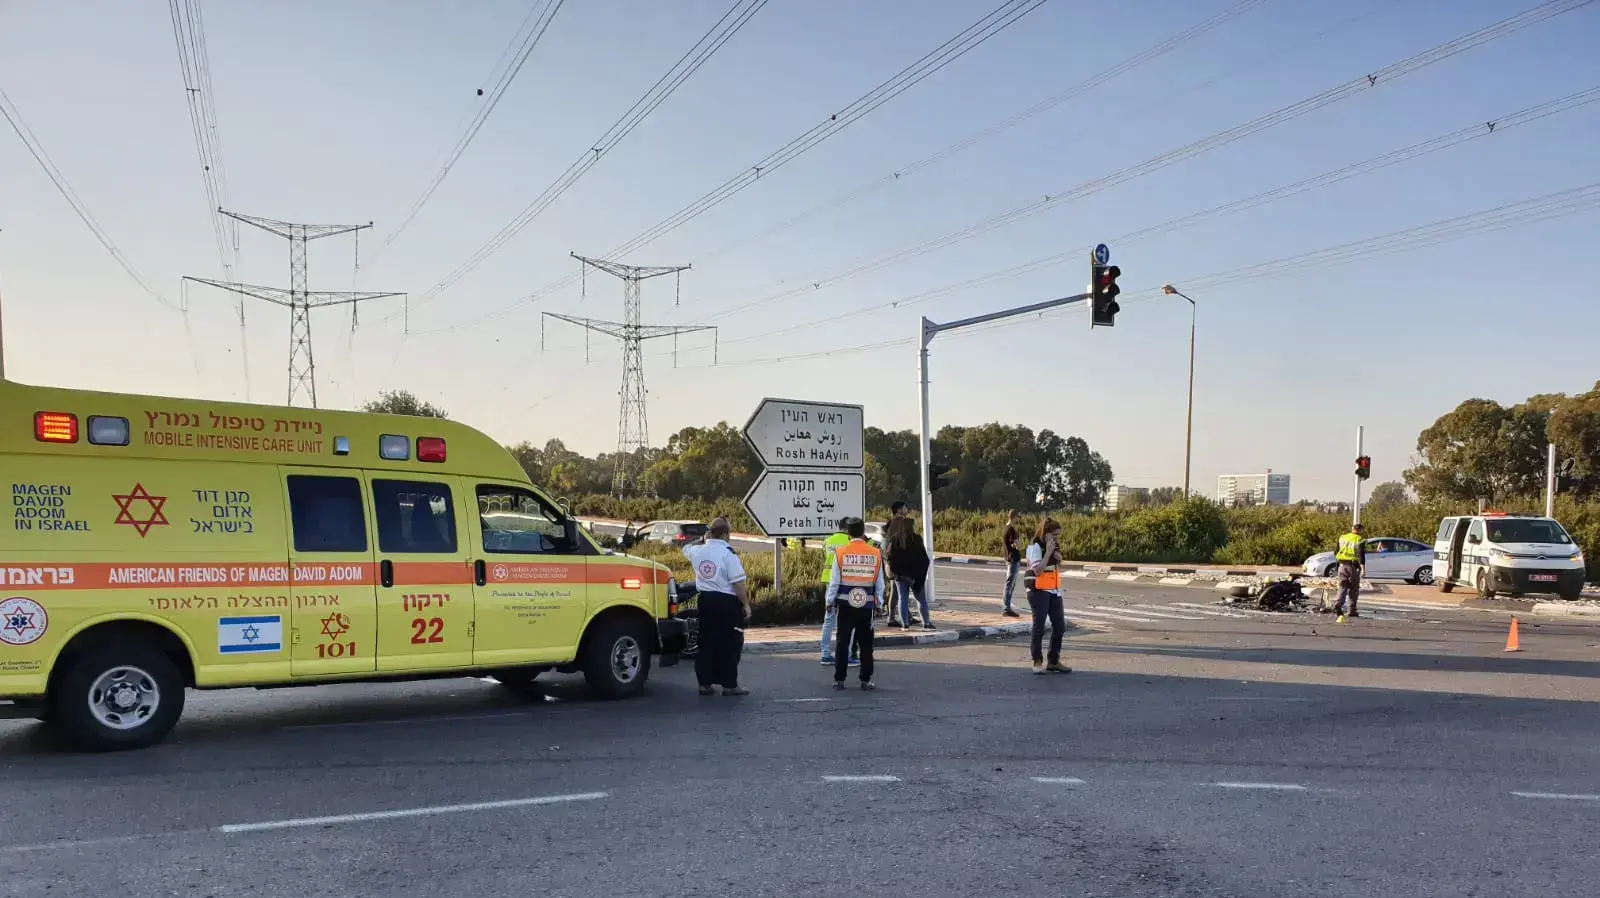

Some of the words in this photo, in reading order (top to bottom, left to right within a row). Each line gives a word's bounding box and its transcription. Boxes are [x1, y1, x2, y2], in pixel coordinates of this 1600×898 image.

[144, 410, 200, 428] נמרץ
[208, 411, 264, 431] טיפול
[781, 410, 808, 422] העין
[818, 412, 843, 424] ראש
[274, 419, 322, 434] ניידת
[144, 431, 192, 446] MOBILE
[197, 434, 259, 450] INTENSIVE
[262, 438, 294, 452] CARE
[297, 439, 323, 454] UNIT
[776, 447, 805, 459] Rosh
[811, 448, 849, 462] HaAyin
[12, 484, 71, 496] MAGEN
[779, 480, 815, 492] תקווה
[824, 480, 848, 492] פתח
[13, 496, 64, 507] DAVID
[192, 489, 218, 503] דוד
[225, 490, 250, 505] מגן
[14, 507, 65, 519] ADOM
[213, 506, 252, 518] אדום
[15, 518, 32, 530] IN
[38, 519, 92, 532] ISRAEL
[190, 518, 254, 533] בישראל
[780, 517, 812, 528] Petah
[817, 517, 841, 530] Tiqw
[109, 567, 174, 584] AMERICAN
[178, 567, 227, 583] FRIENDS
[230, 567, 246, 582] OF
[248, 567, 288, 582] MAGEN
[294, 566, 326, 581] DAVID
[330, 566, 362, 581] ADOM
[148, 595, 218, 610] הלאומי
[228, 594, 288, 608] ההצלה
[296, 594, 340, 608] ארגון
[402, 594, 450, 612] ירקון
[411, 617, 444, 644] 22
[315, 642, 356, 658] 101
